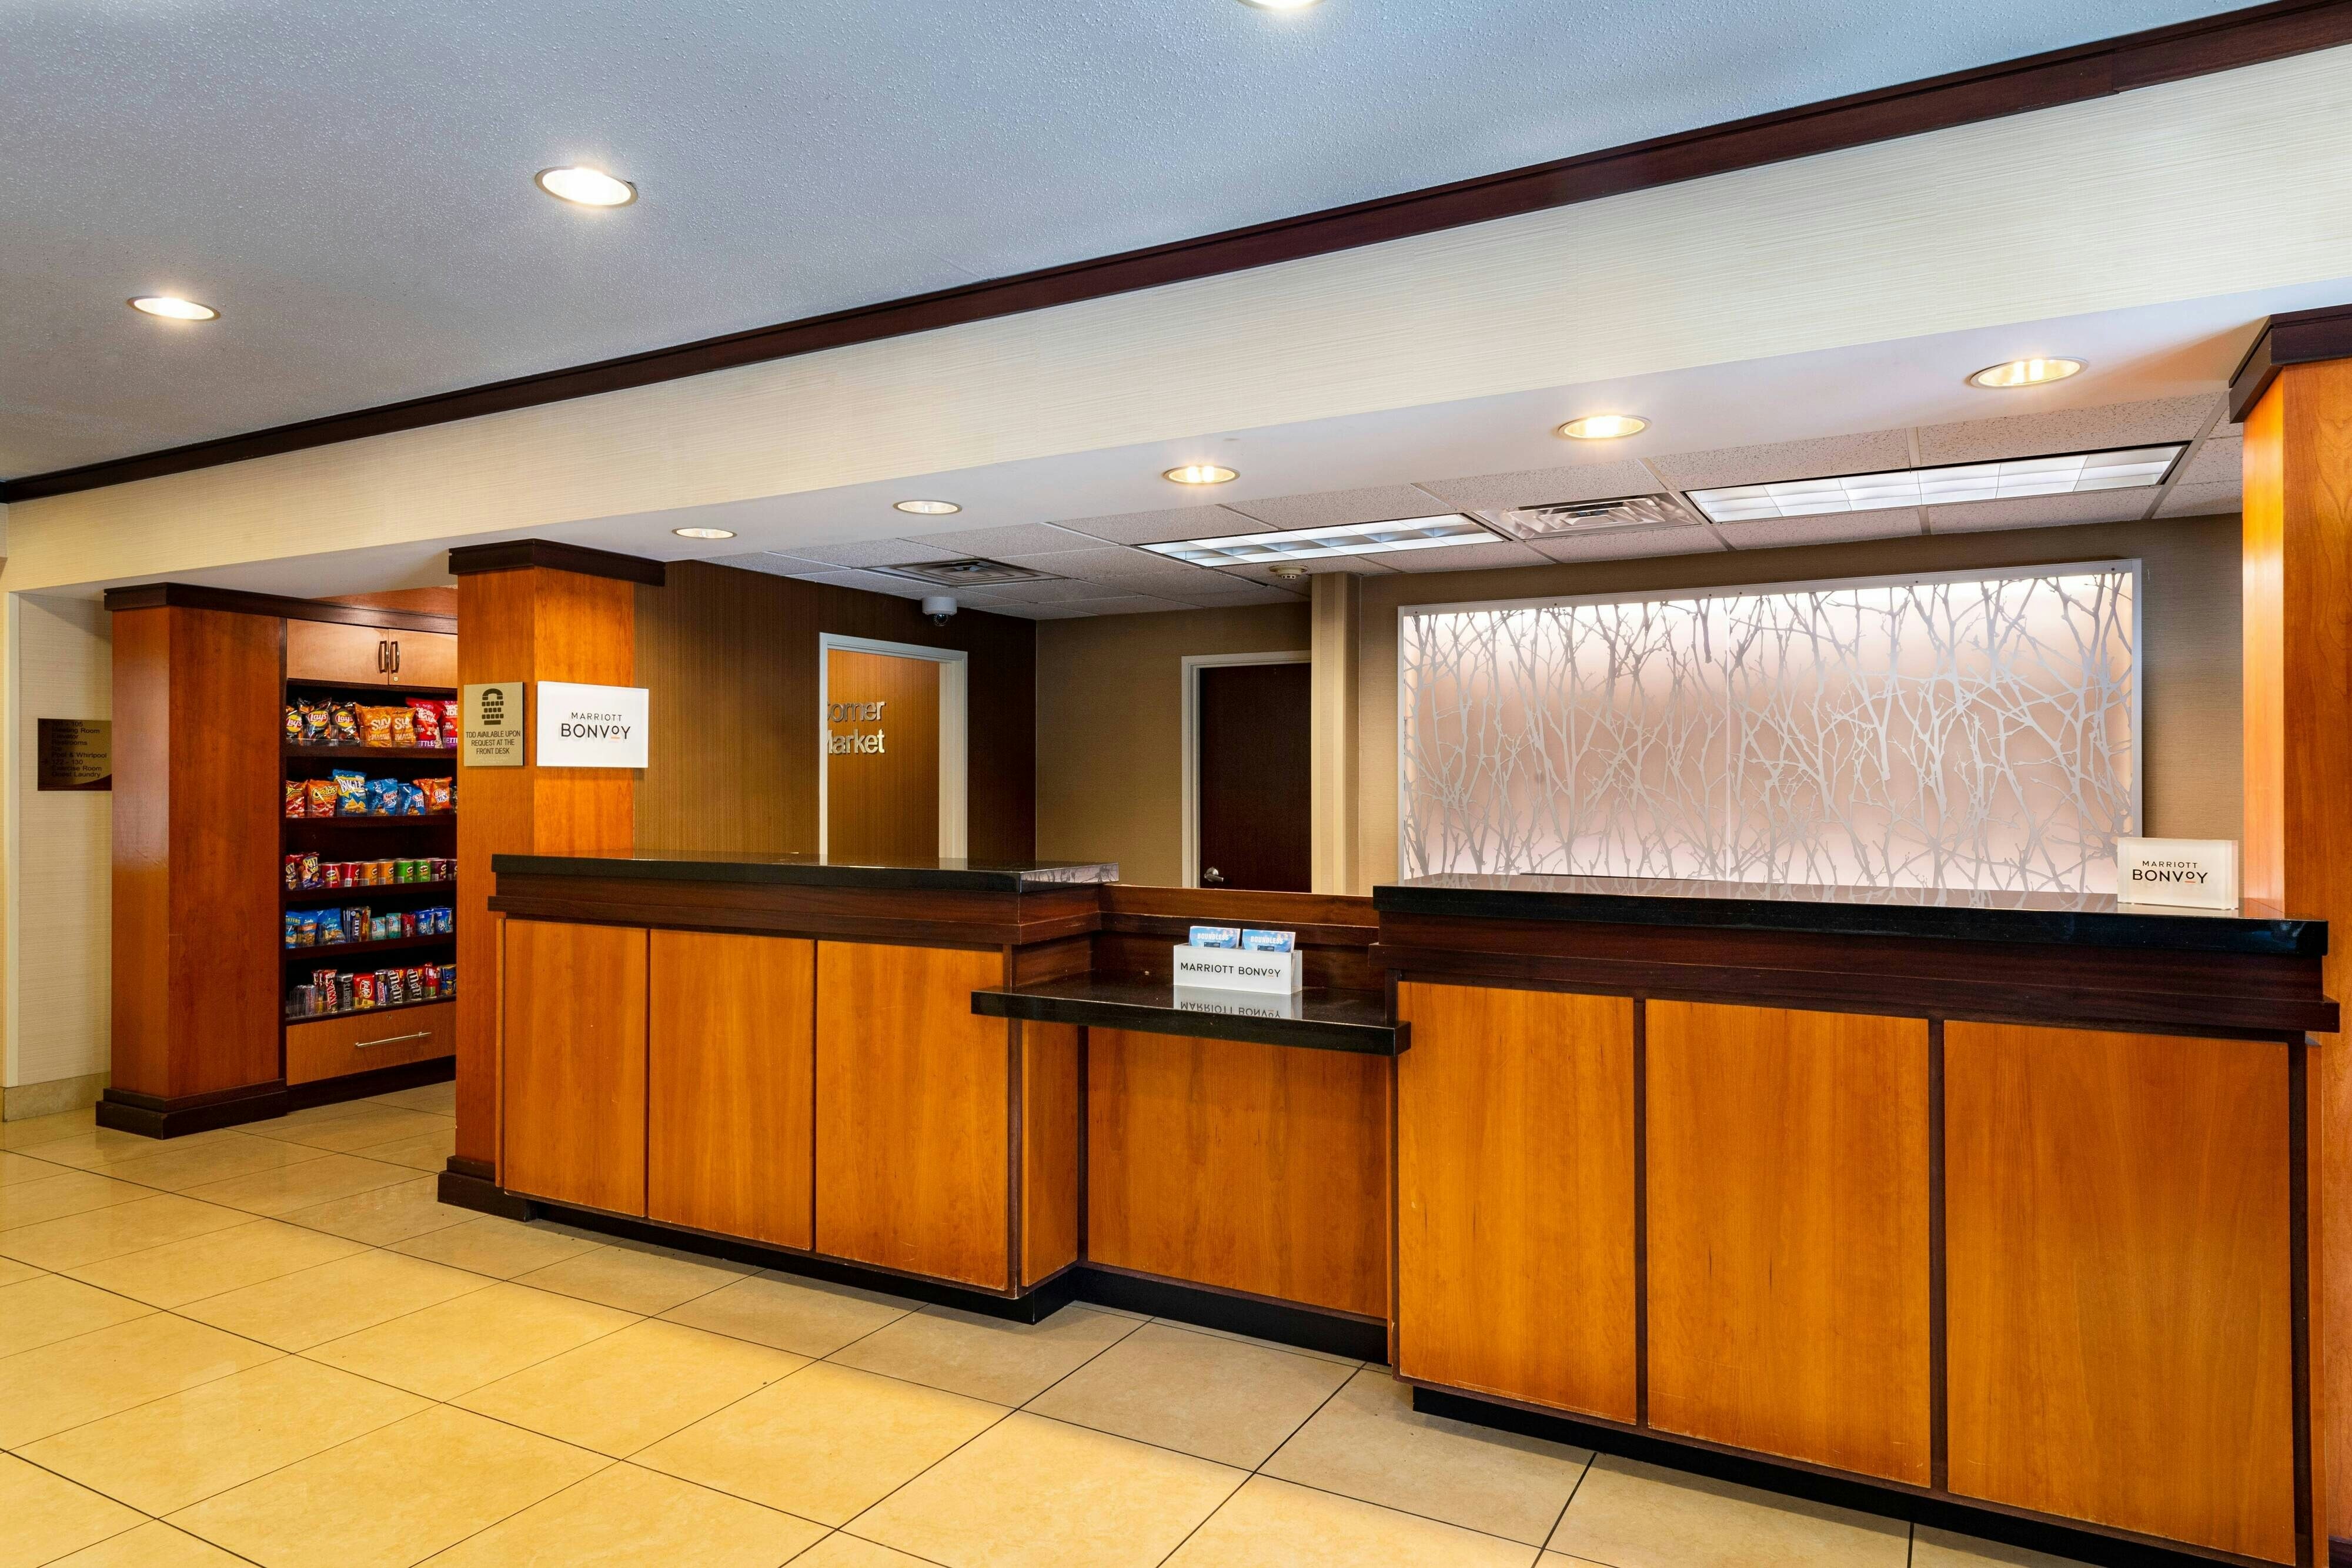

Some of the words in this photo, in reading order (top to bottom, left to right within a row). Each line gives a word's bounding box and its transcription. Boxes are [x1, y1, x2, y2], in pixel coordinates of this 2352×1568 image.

[310, 712, 327, 721] Lay's
[571, 712, 622, 721] MARRIOTT
[827, 701, 885, 722] orner
[287, 720, 302, 728] Lay's
[561, 723, 631, 740] BONVOY
[2133, 870, 2208, 883] BONVOY
[1251, 936, 1283, 944] BOUNDLESS
[1180, 962, 1234, 974] MARRIOTT
[1238, 967, 1281, 977] BONVOY
